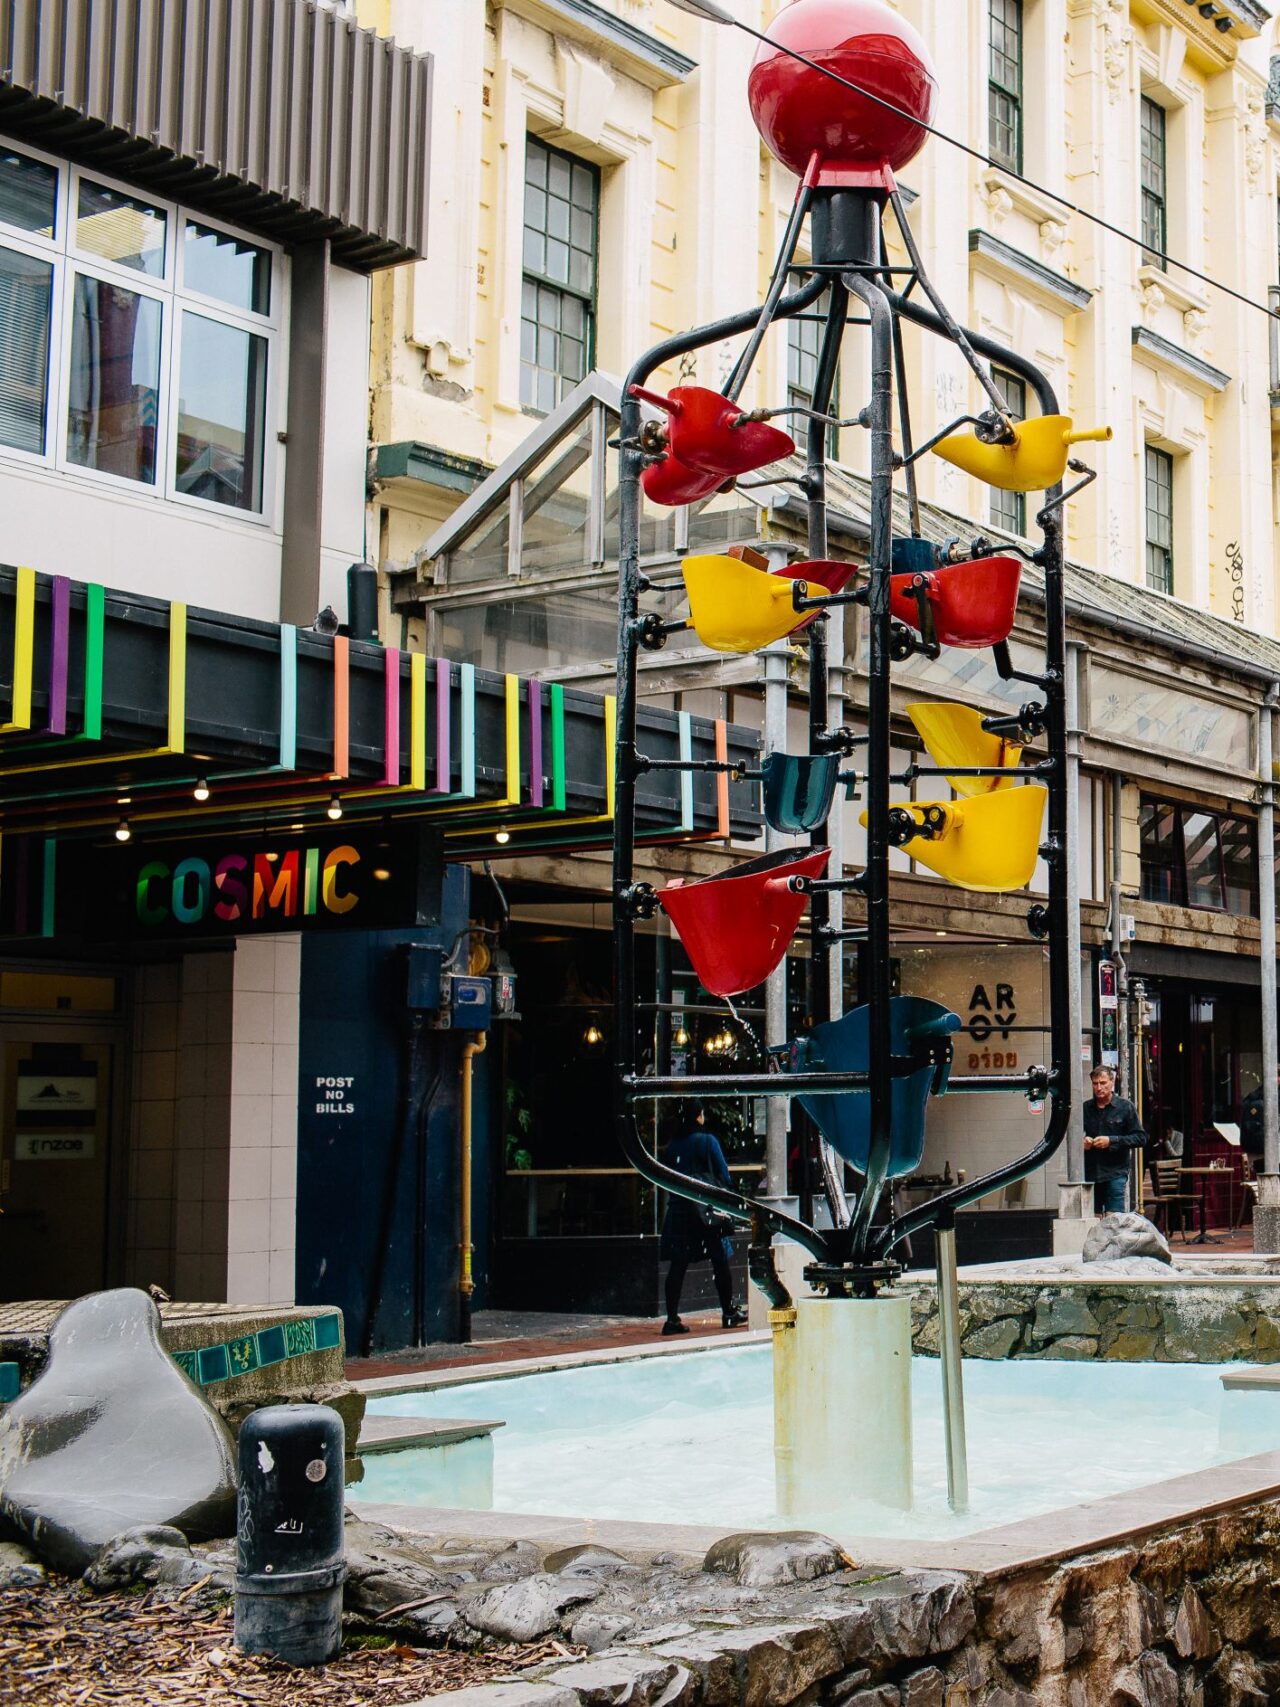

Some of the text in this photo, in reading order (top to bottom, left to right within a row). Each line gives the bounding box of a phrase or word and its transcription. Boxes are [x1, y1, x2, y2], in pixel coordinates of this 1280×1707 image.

[136, 845, 361, 924] COSMIC
[968, 983, 1015, 1010] AR
[969, 1013, 1017, 1041] OY
[968, 1046, 1017, 1069] อร่อย
[316, 1077, 354, 1088] POST
[325, 1090, 344, 1100] NO
[316, 1103, 354, 1114] BILLS
